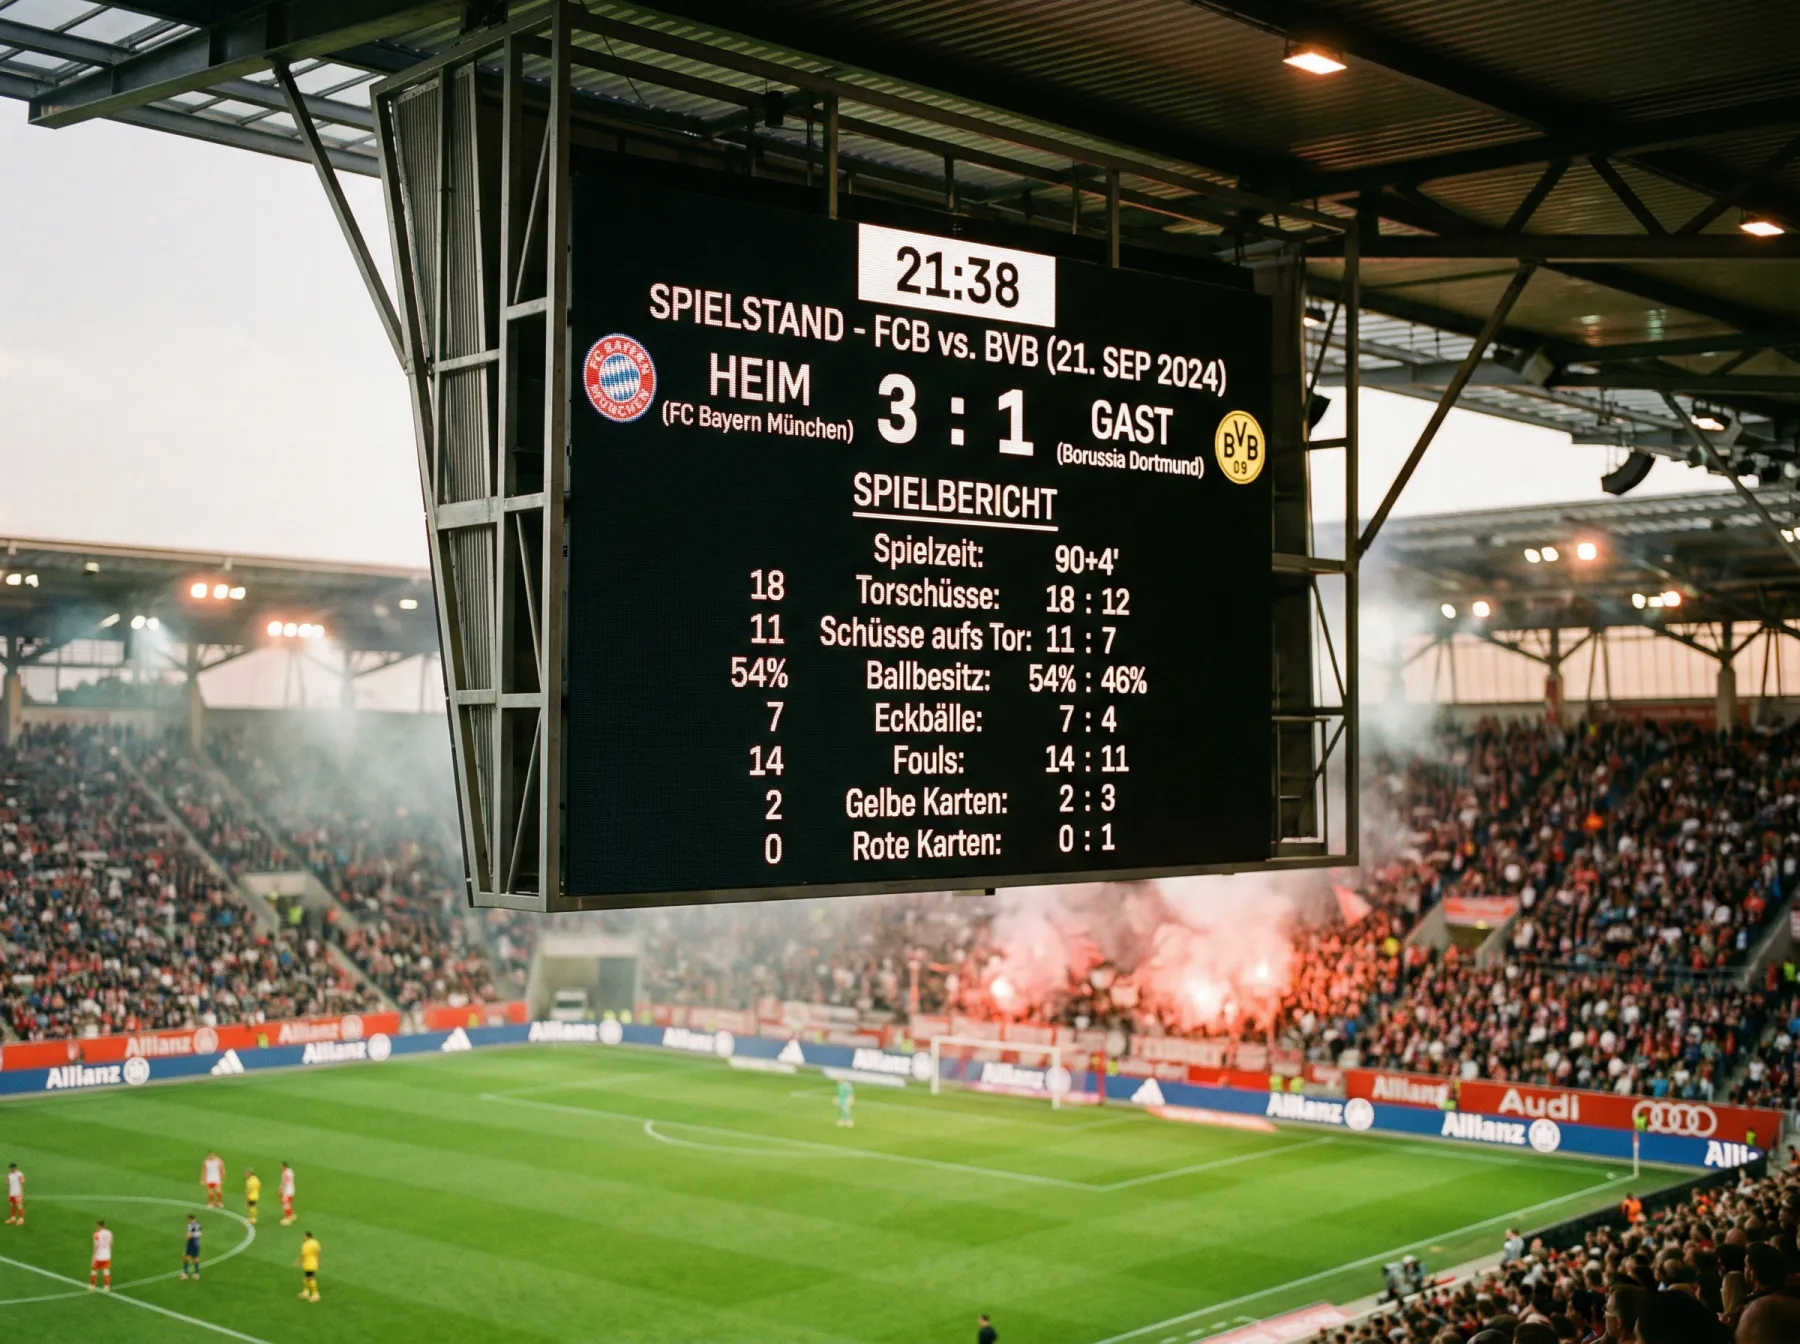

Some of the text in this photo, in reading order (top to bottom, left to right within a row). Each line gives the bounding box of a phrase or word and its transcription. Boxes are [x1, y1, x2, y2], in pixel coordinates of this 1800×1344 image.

[896, 245, 1019, 309] 21:38
[650, 284, 1227, 397] SPIELSTAND - FCB vs. BVB (21. SEP 2024)
[711, 353, 810, 406] HEIM
[663, 400, 853, 444] (FC Bayern München)
[878, 374, 1034, 456] 3 : 1
[1092, 400, 1173, 445] GAST
[1224, 420, 1258, 460] BVB
[1057, 442, 1205, 480] (Borussia Dortmund)
[1233, 460, 1247, 474] 09
[854, 472, 1058, 521] SPIELBERICHT
[874, 533, 984, 570] Spielzeit:
[1056, 545, 1119, 575] 90+4'
[751, 570, 785, 600] 18
[856, 575, 1000, 610] Torschüsse:
[1047, 585, 1130, 616] 18 : 12
[751, 614, 785, 644] 11
[820, 616, 1032, 652] Schüsse aufs Tor:
[1047, 625, 1116, 654] 11 : 7
[731, 657, 788, 688] 54%
[867, 661, 991, 692] Ballbesitz:
[1029, 664, 1147, 694] 54% : 46%
[767, 702, 784, 731] 7
[876, 703, 983, 733] Eckbälle:
[1060, 705, 1117, 733] 7 : 4
[749, 746, 784, 775] 14
[894, 745, 965, 775] Fouls:
[1046, 745, 1130, 773] 14 : 11
[765, 790, 782, 819] 2
[846, 787, 1008, 818] Gelbe Karten:
[1059, 784, 1115, 812] 2 : 3
[765, 834, 782, 864] 0
[854, 829, 1002, 860] Rote Karten:
[1059, 823, 1115, 852] 0 : 1
[125, 1034, 192, 1058] Allianz
[46, 1064, 121, 1089] Allianz
[1266, 1091, 1343, 1124] Allianz
[1498, 1087, 1580, 1121] Audi
[1441, 1111, 1526, 1145] Allianz
